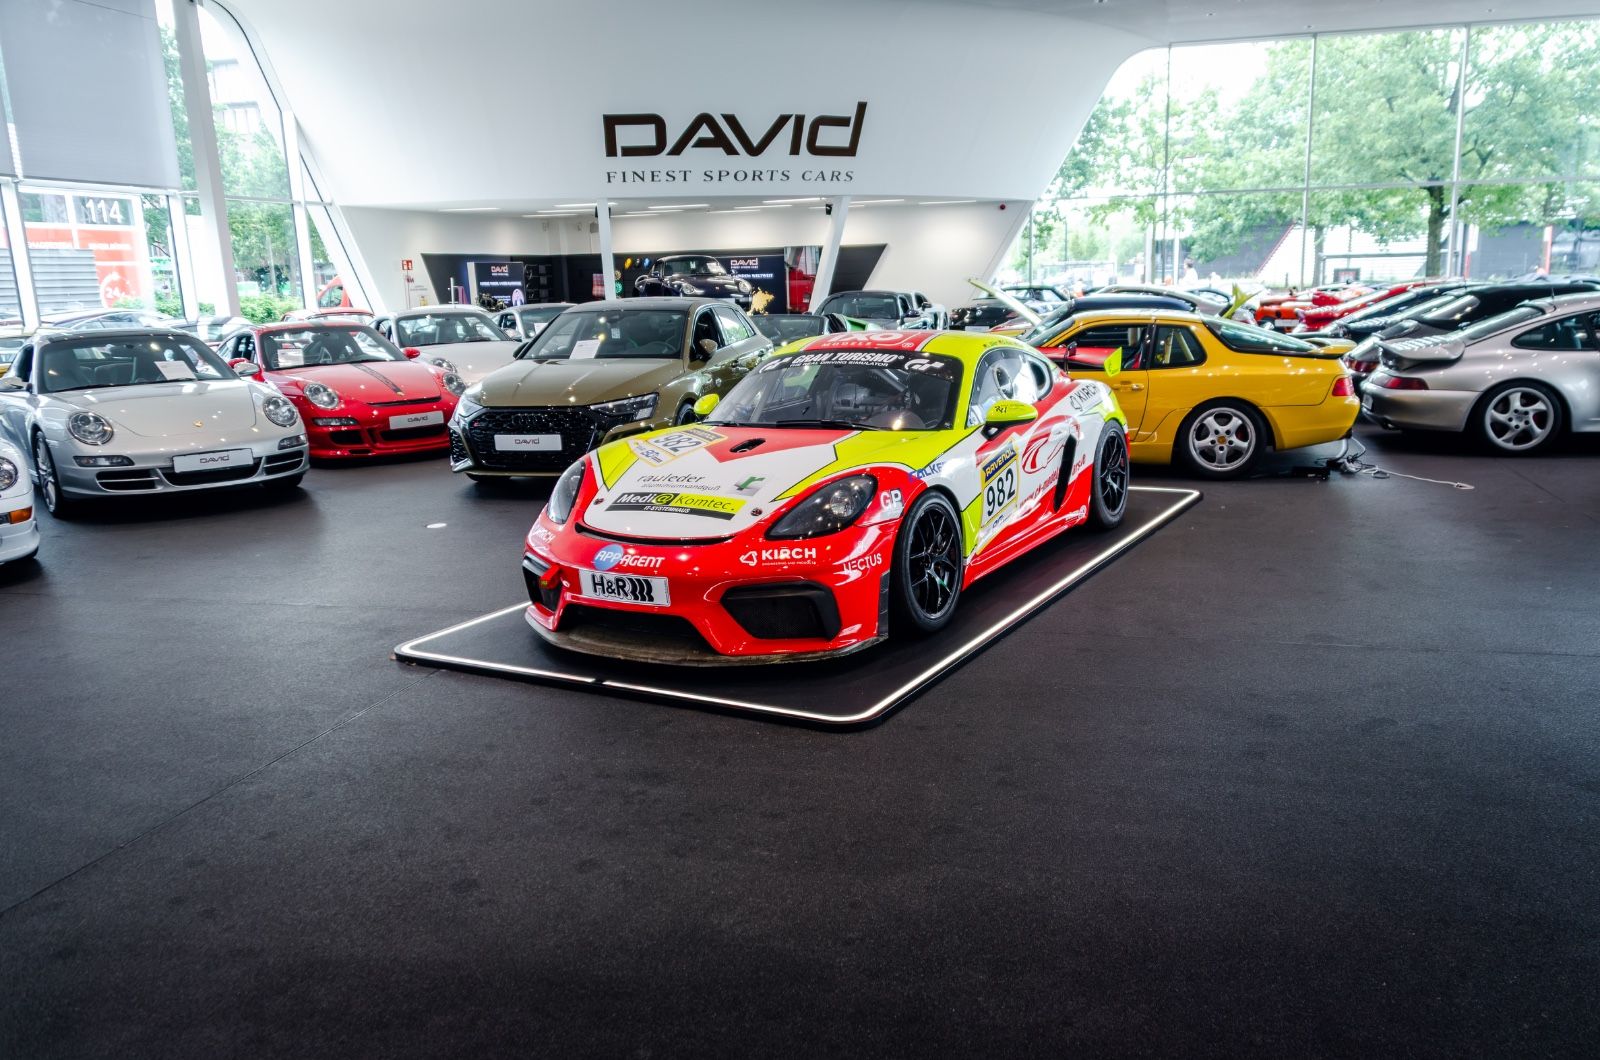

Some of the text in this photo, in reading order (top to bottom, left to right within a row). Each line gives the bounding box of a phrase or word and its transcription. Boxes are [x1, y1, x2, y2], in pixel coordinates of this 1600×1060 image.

[606, 169, 855, 184] FINEST SPORTS CARS
[86, 199, 124, 224] 114
[792, 353, 834, 365] GRAN
[653, 433, 704, 453] 982
[636, 473, 707, 483] rauleder
[986, 468, 1016, 517] 982
[761, 547, 817, 561] KIRCH
